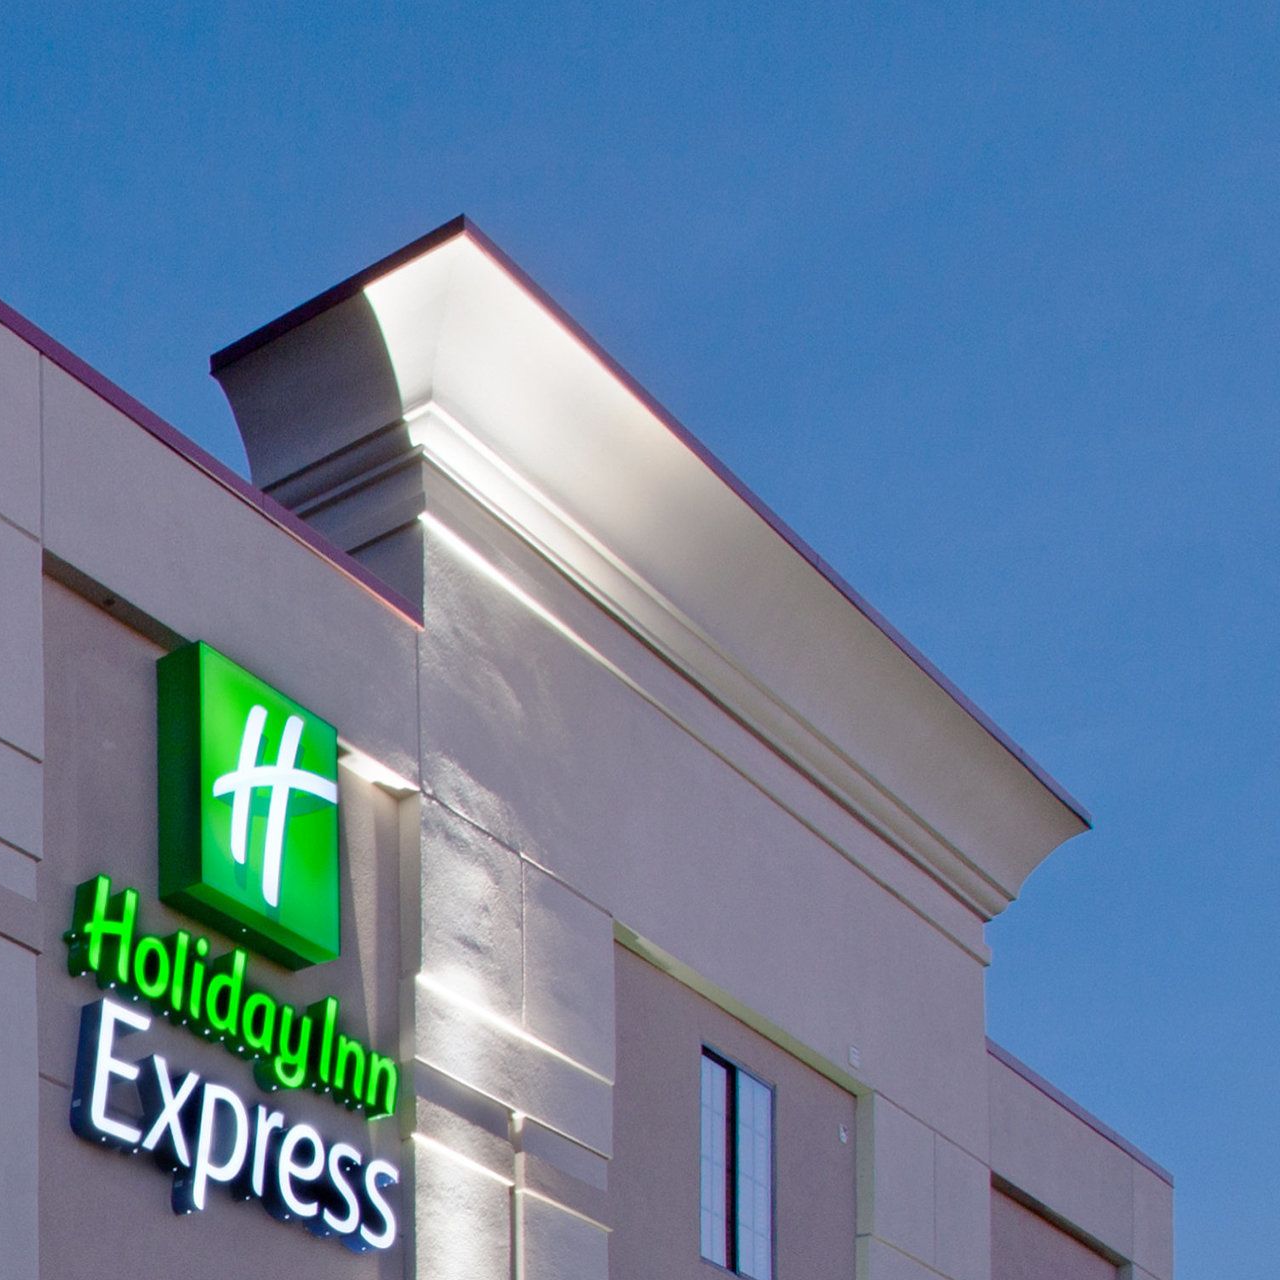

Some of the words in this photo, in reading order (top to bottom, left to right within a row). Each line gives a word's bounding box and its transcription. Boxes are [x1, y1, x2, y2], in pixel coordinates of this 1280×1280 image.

[213, 704, 338, 907] H
[84, 874, 311, 1089] Holiday
[319, 995, 399, 1117] Inn
[90, 998, 400, 1249] Express
